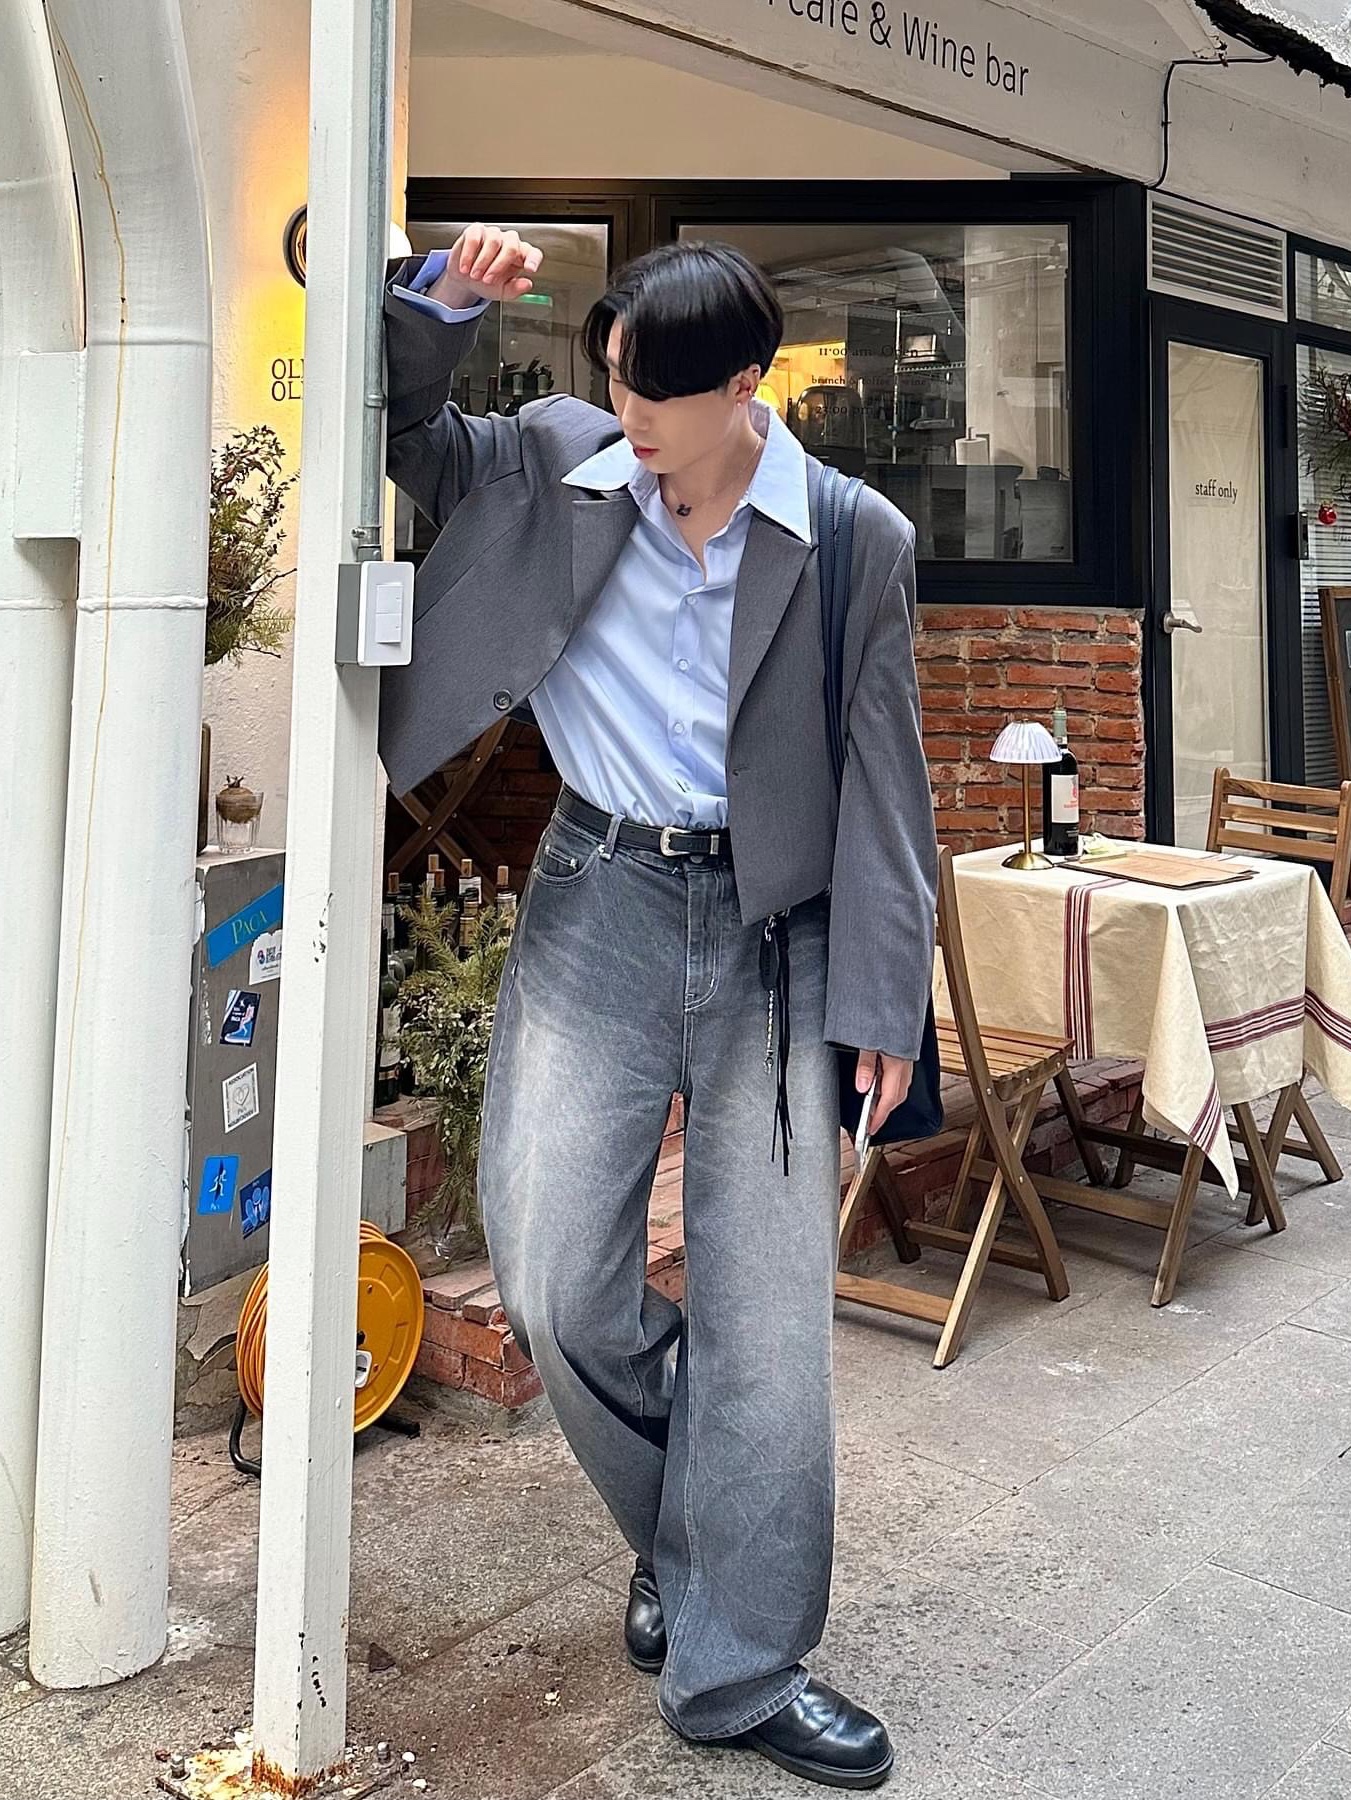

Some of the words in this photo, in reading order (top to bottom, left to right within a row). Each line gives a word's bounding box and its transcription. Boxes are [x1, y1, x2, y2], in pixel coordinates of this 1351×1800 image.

[869, 1, 892, 49] &
[902, 11, 976, 78] Wine
[986, 42, 1030, 97] bar
[271, 380, 304, 402] OL
[1195, 478, 1217, 497] staff
[1217, 480, 1238, 505] only
